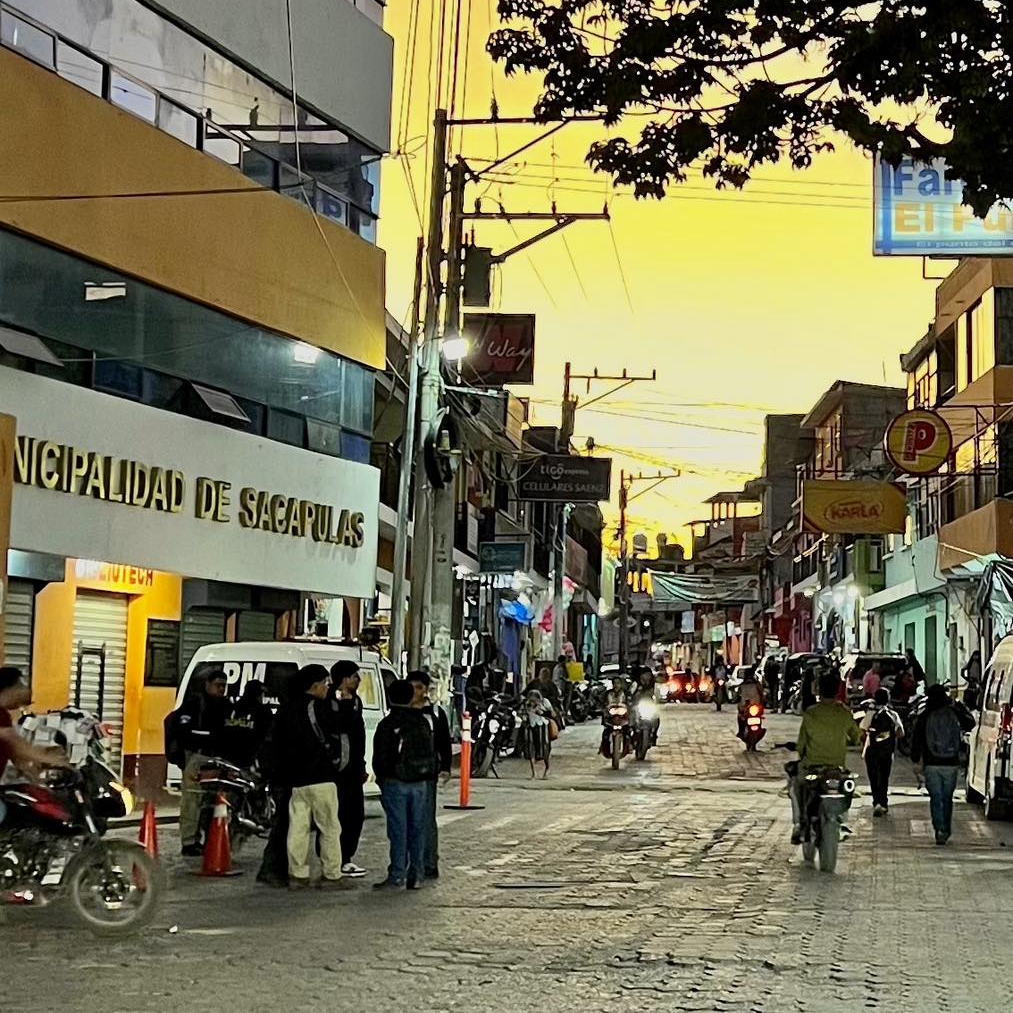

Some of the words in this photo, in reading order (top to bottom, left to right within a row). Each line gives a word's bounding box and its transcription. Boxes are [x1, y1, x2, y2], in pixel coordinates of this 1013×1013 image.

[894, 203, 934, 233] El
[935, 241, 980, 249] punto
[487, 339, 532, 372] Way
[195, 476, 231, 523] DE
[238, 487, 365, 548] SACAPULAS
[831, 504, 881, 519] KARLA
[223, 662, 267, 697] PM
